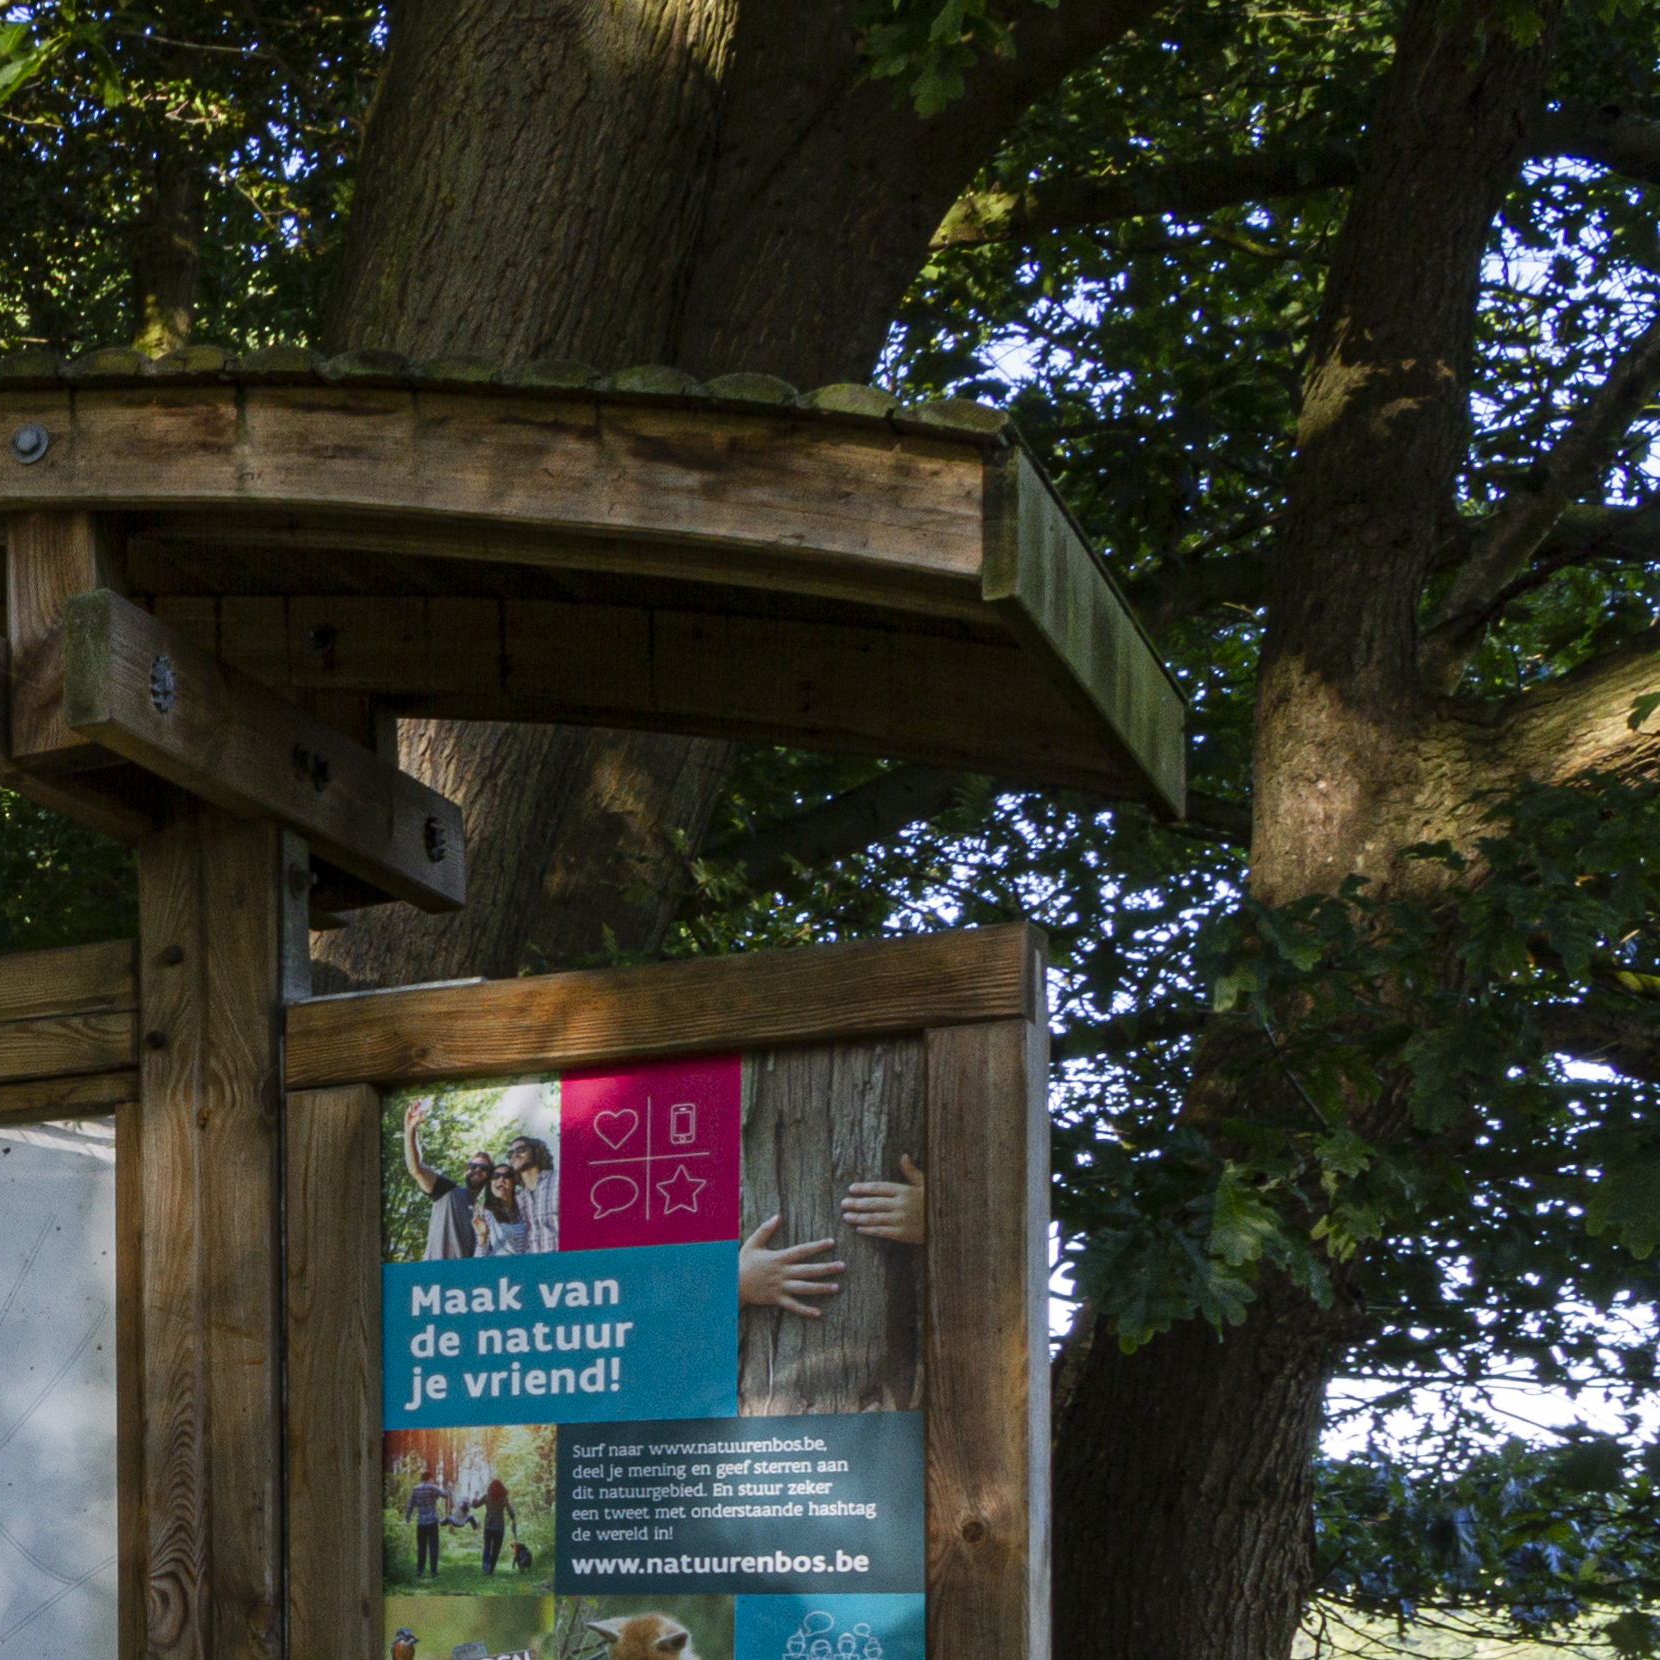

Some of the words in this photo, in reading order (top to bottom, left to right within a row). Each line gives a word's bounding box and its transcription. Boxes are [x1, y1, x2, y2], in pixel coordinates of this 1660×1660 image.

[410, 1277, 521, 1317] Maak
[538, 1279, 619, 1309] van
[410, 1325, 461, 1359] de
[476, 1319, 633, 1355] natuur
[405, 1366, 447, 1411] je
[462, 1357, 621, 1398] vriend!
[572, 1444, 606, 1458] Surf
[608, 1447, 645, 1458] naar
[647, 1438, 828, 1461] www.natuurenbos.be,
[571, 1464, 605, 1478] deel
[609, 1463, 624, 1482] je
[627, 1462, 687, 1482] mening
[690, 1466, 712, 1476] en
[715, 1460, 752, 1480] geef
[752, 1459, 813, 1474] sterren
[816, 1462, 850, 1473] aan
[572, 1485, 594, 1499] dit
[599, 1483, 707, 1503] natuurgebied.
[712, 1482, 733, 1497] En
[738, 1481, 783, 1496] stuur
[787, 1480, 833, 1495] zeker
[570, 1510, 599, 1520] een
[603, 1505, 651, 1519] tweet
[653, 1504, 687, 1519] met
[690, 1503, 805, 1518] onderstaande
[807, 1502, 877, 1521] hashtag
[571, 1527, 591, 1541] de
[595, 1526, 648, 1541] wereld
[653, 1526, 673, 1540] in!
[571, 1550, 870, 1574] www.natuurenbos.be
